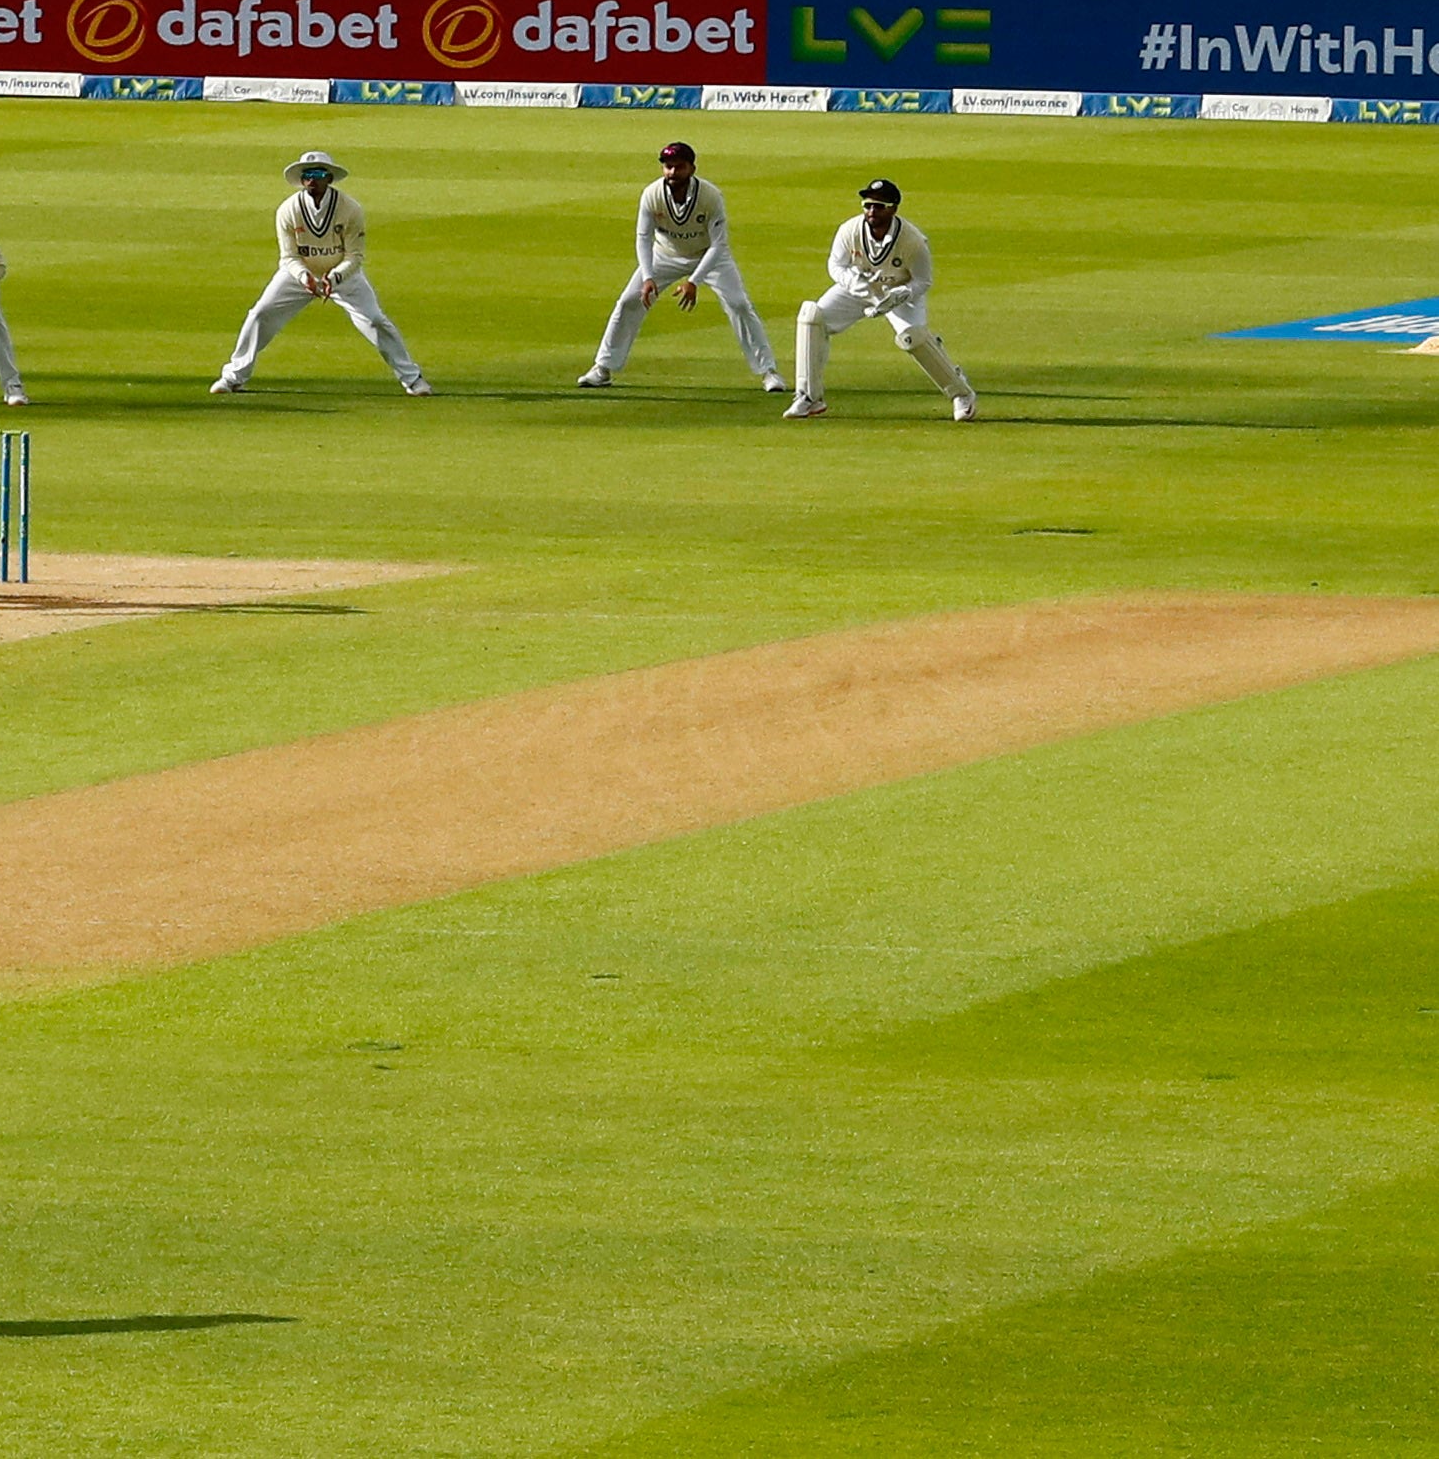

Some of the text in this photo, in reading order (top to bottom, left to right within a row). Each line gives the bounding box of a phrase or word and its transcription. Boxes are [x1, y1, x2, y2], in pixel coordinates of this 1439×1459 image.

[513, 0, 754, 62] dafabet
[233, 86, 319, 95] Car Home
[464, 89, 567, 102] LV.com/insurance
[715, 92, 809, 103] In With Heart
[962, 96, 1067, 108] LV.com/insurance
[1231, 104, 1318, 114] Car Home
